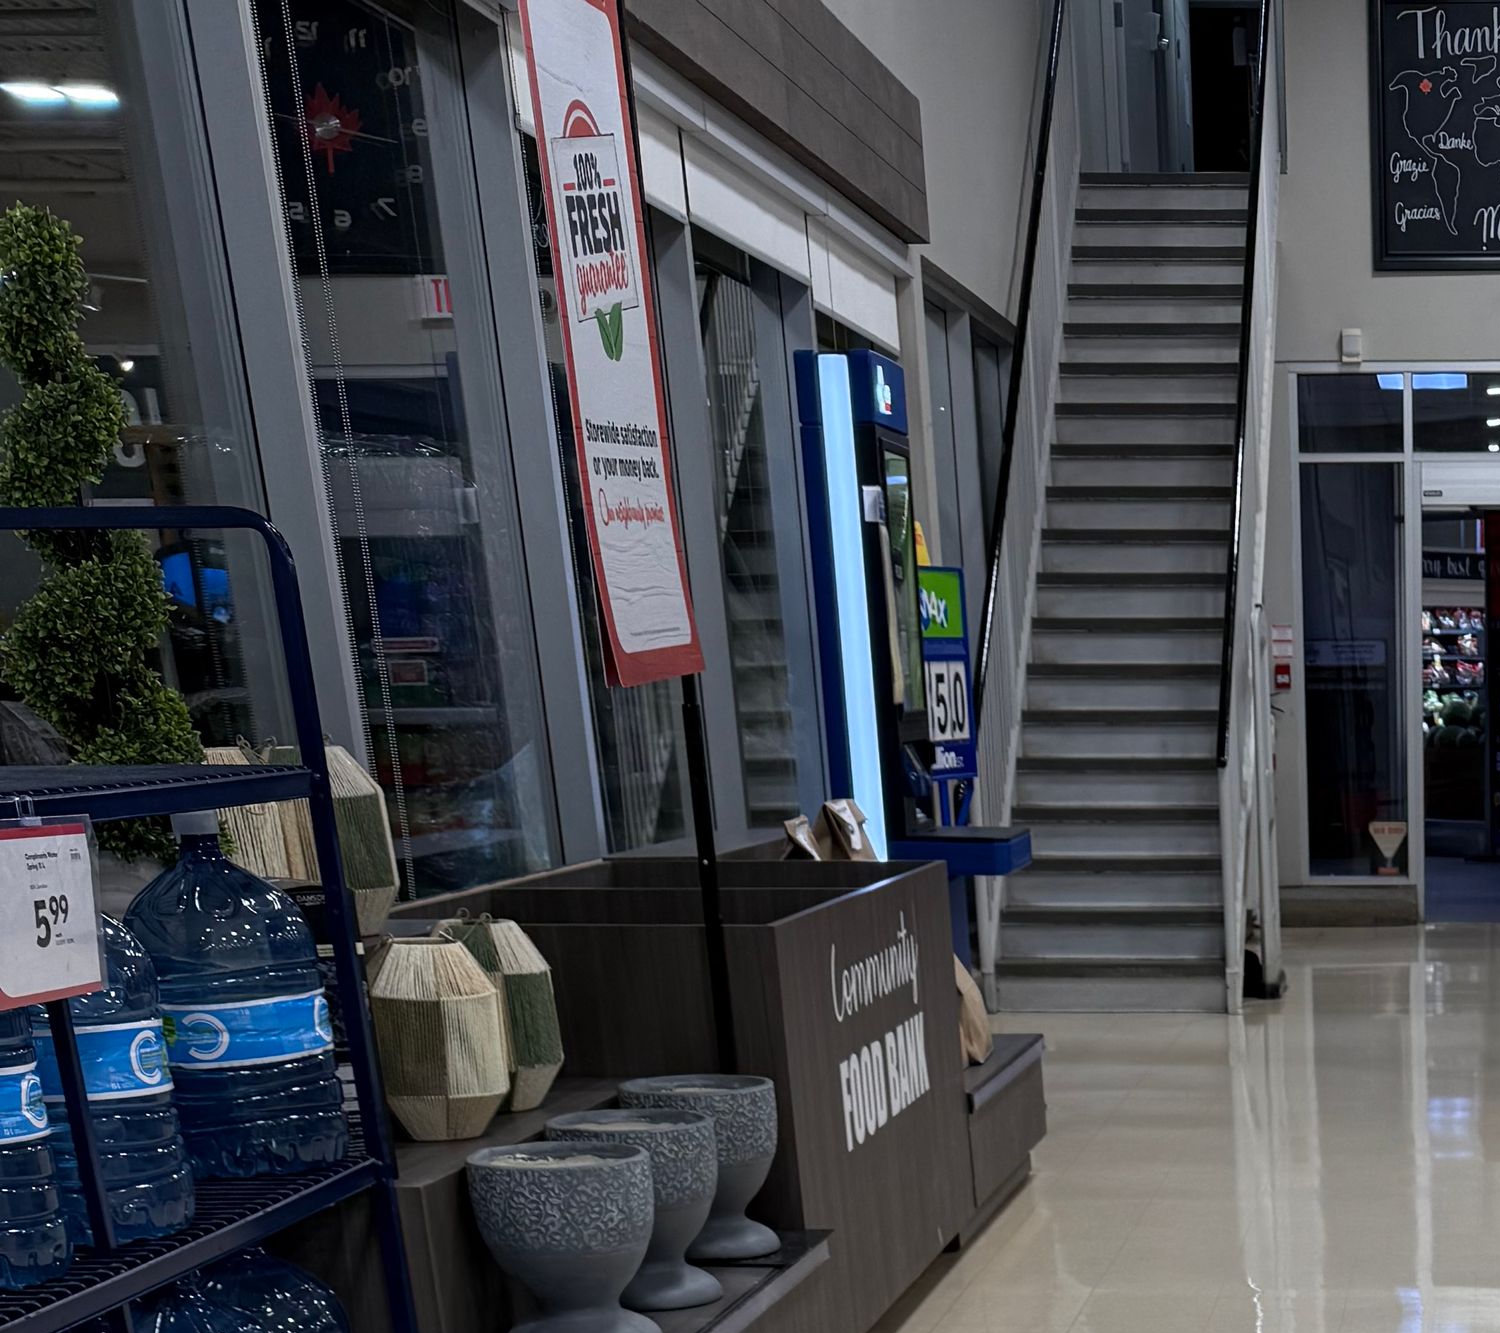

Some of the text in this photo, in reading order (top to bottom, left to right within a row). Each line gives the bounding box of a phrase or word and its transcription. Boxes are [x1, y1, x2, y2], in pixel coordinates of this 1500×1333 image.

[1438, 132, 1474, 150] Danke
[573, 152, 602, 191] 100%
[1390, 152, 1429, 183] Grazie
[565, 191, 625, 258] FRESH
[1395, 202, 1441, 232] Gracias
[576, 250, 629, 315] guarantee
[585, 419, 658, 448] Storewide satisfaction
[593, 457, 601, 475] or
[601, 457, 618, 480] your
[619, 458, 642, 481] money
[830, 910, 919, 1023] Community
[839, 1011, 930, 1152] FOOD BANK
